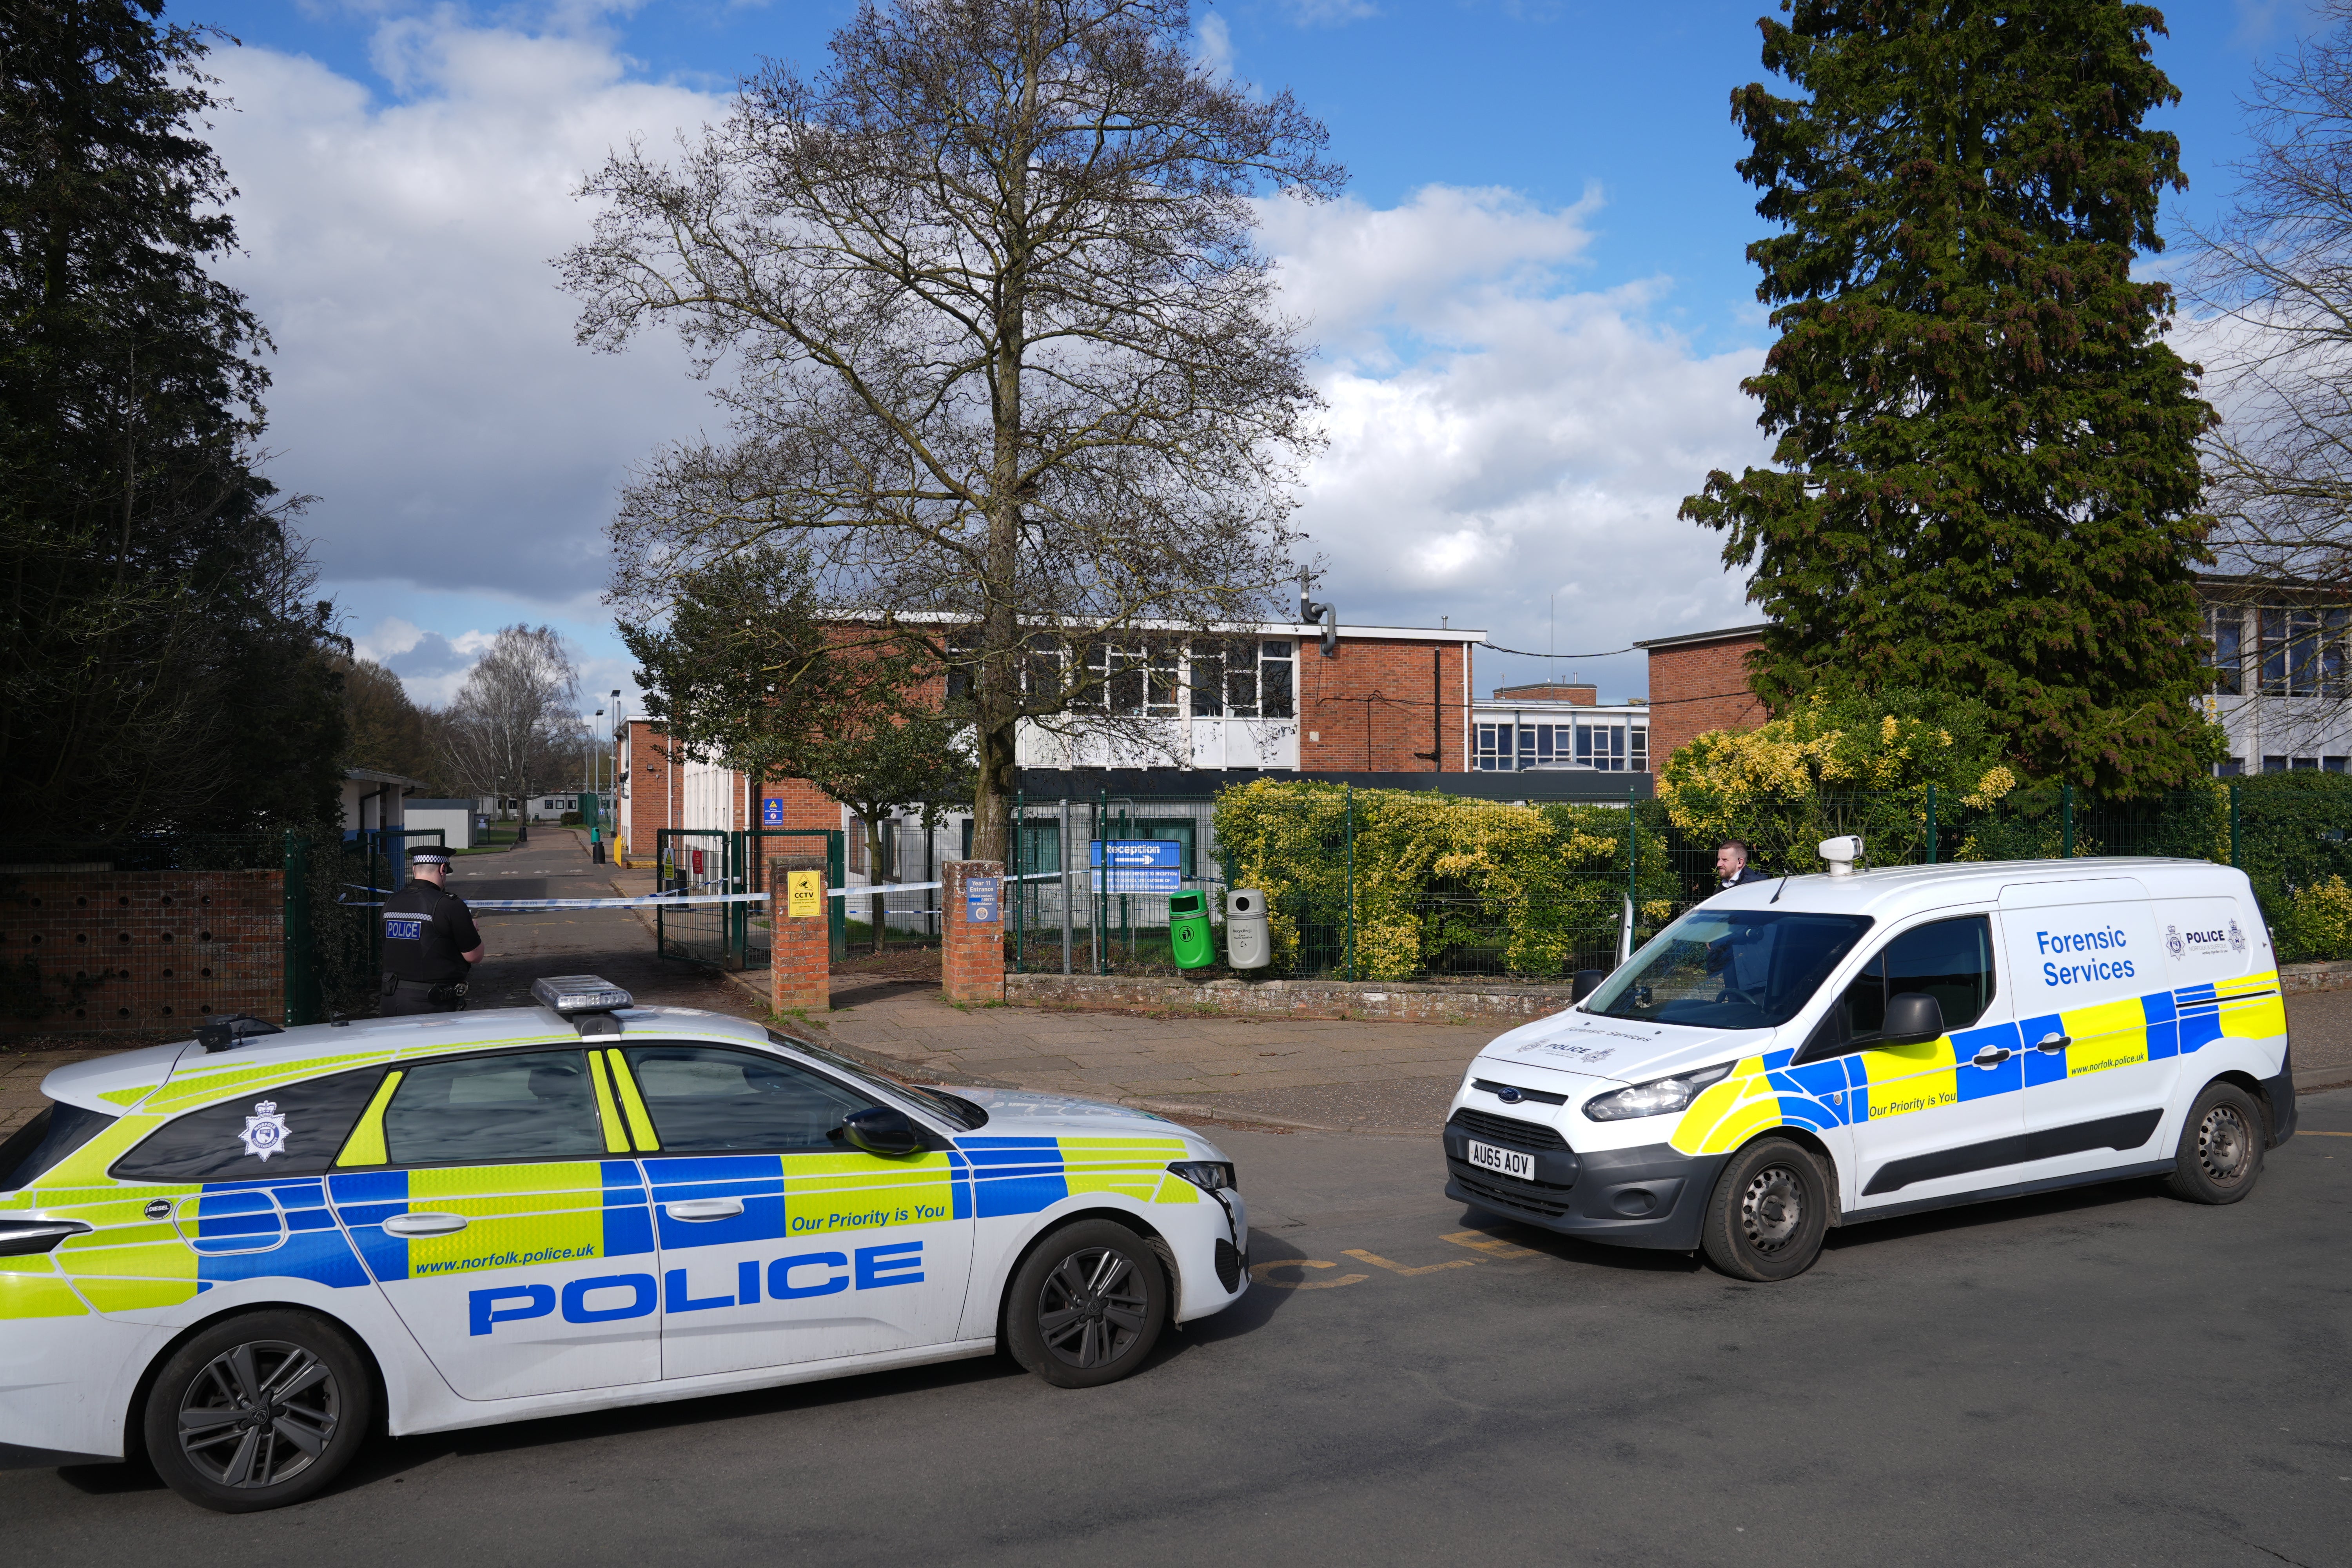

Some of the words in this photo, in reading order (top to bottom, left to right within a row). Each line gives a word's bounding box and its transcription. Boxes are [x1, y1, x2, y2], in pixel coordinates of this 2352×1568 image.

[1107, 845, 1160, 855] Reception
[388, 922, 417, 937] POLICE
[2186, 930, 2225, 944] POLICE
[2036, 925, 2126, 955] Forensic
[2043, 958, 2135, 986] Services
[1606, 1031, 1652, 1042] Services
[1544, 1044, 1592, 1054] POLICE
[2071, 1053, 2144, 1075] www.norfolk.police.uk
[1501, 1089, 1515, 1098] Ford
[1869, 1106, 1887, 1117] Our
[1890, 1098, 1925, 1113] Priority
[1928, 1096, 1935, 1105] is
[1938, 1093, 1956, 1103] You
[254, 1122, 277, 1131] NORFOLK
[252, 1136, 278, 1148] CONSTABULARY
[1474, 1144, 1501, 1168] AU65
[1504, 1152, 1528, 1174] AOV
[792, 1216, 824, 1231] Our
[828, 1210, 890, 1227] Priority
[895, 1207, 908, 1221] is
[915, 1205, 945, 1219] You
[416, 1243, 595, 1274] www.norfolk.police.uk
[469, 1241, 924, 1336] POLICE
